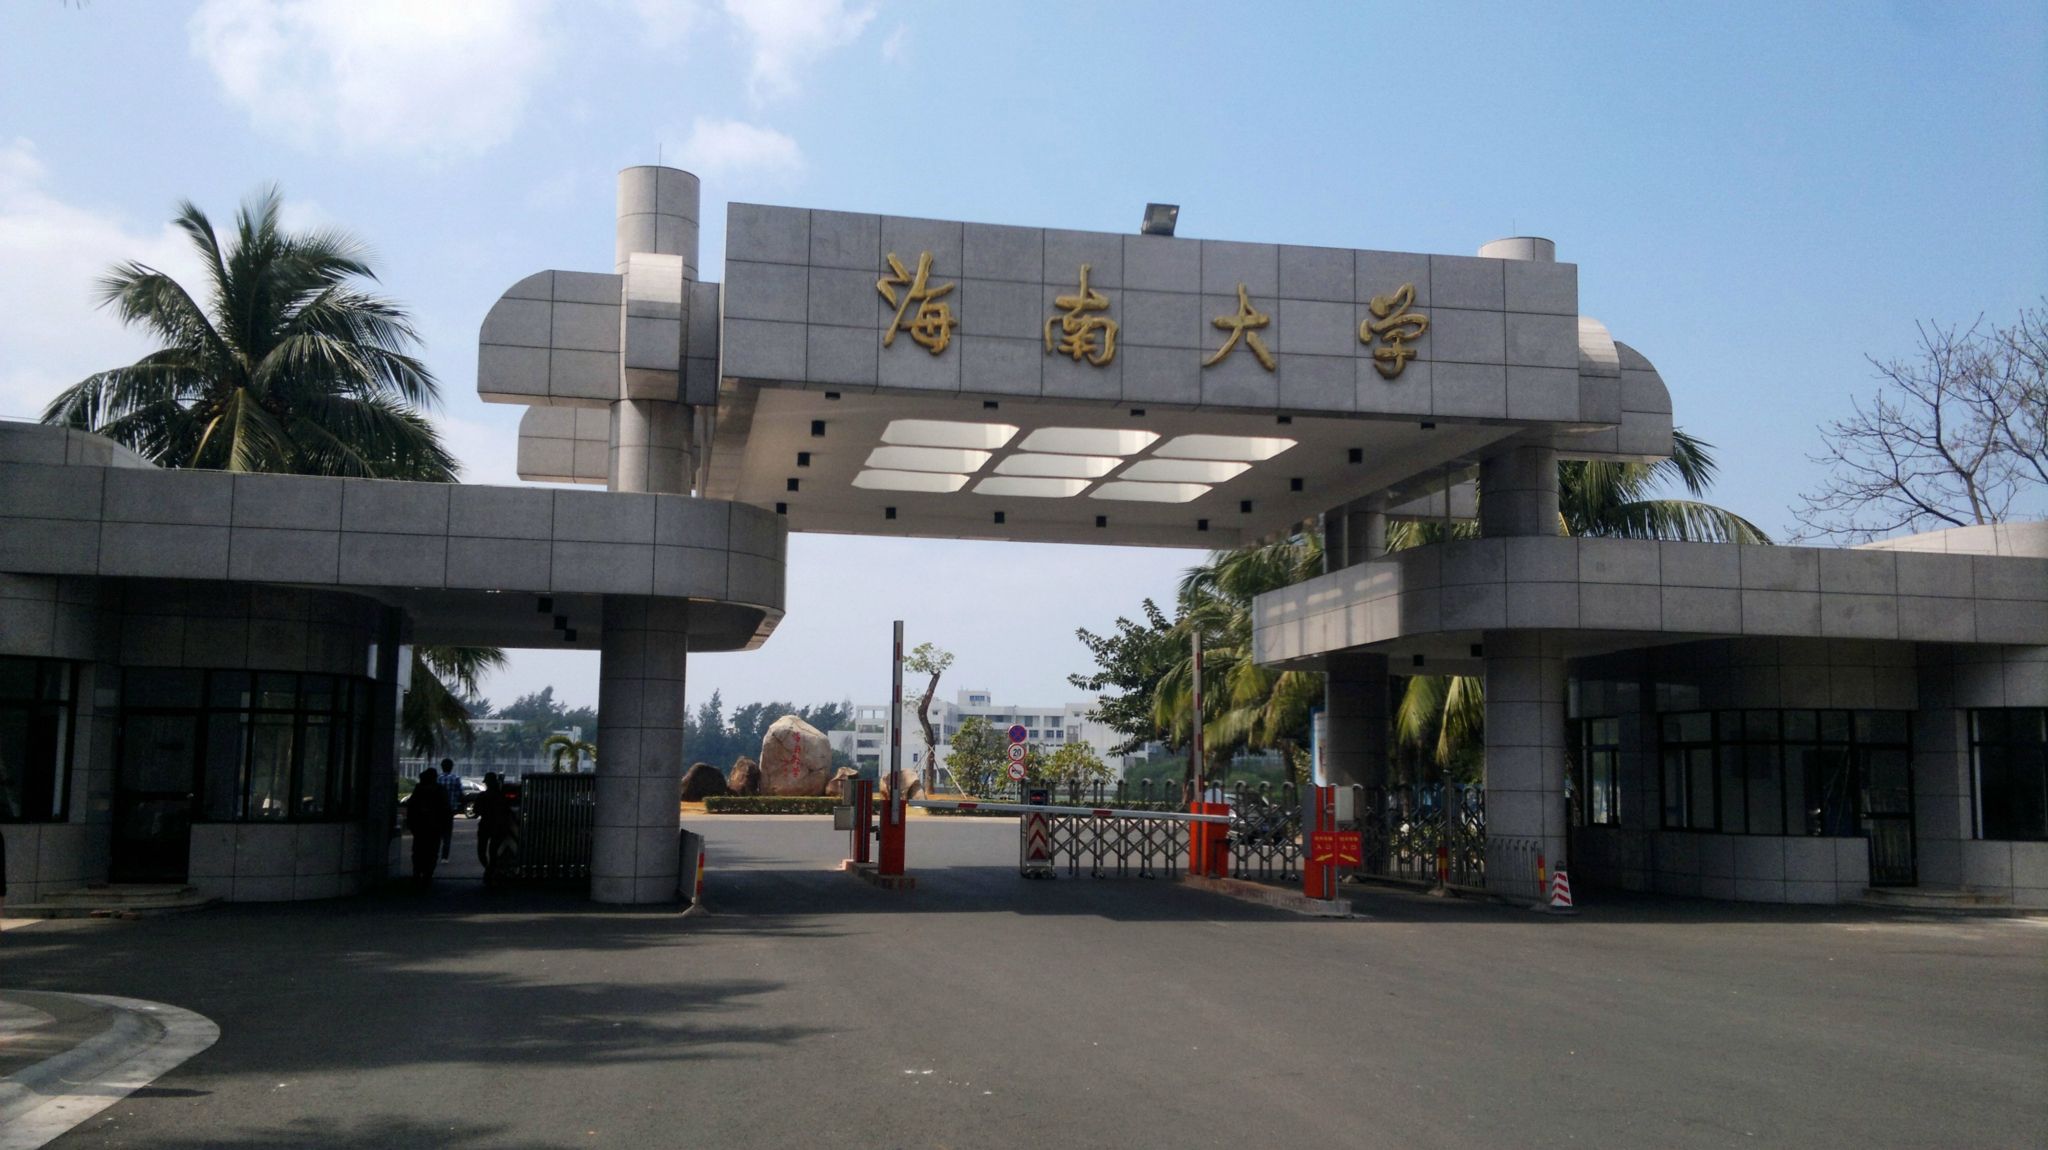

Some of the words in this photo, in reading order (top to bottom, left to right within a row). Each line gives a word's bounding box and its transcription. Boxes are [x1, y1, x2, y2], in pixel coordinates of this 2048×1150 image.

[876, 250, 1429, 380] 海南大学
[1013, 748, 1022, 757] 20
